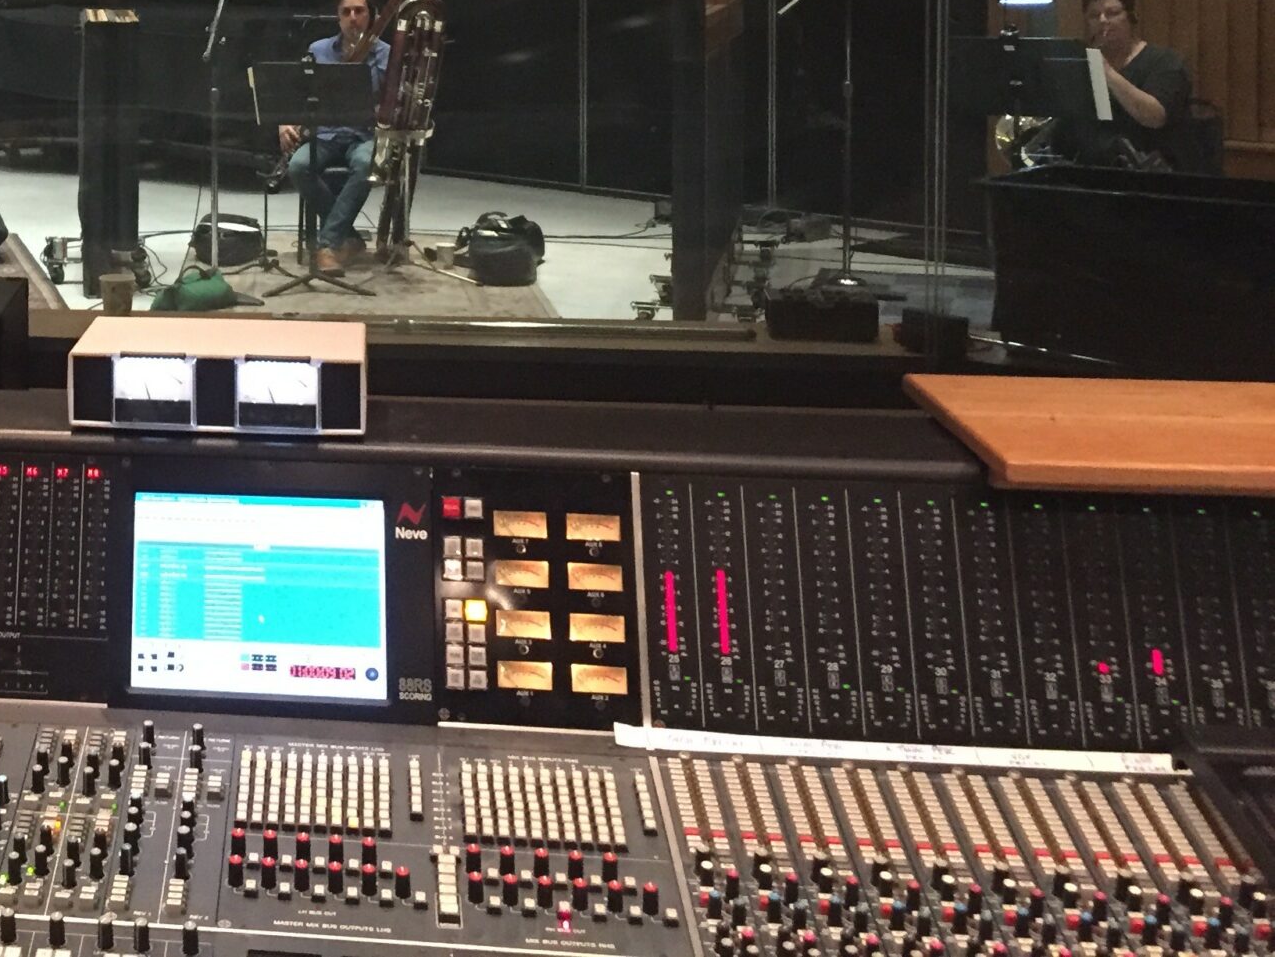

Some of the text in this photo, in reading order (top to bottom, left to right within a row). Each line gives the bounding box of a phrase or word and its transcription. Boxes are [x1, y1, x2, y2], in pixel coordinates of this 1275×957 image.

[395, 526, 428, 540] Neve
[774, 659, 784, 668] 27
[827, 662, 839, 671] 28
[880, 664, 893, 674] 29
[935, 667, 947, 676] 30
[990, 669, 1001, 678] 31
[1045, 672, 1057, 681] 32
[1099, 674, 1112, 684] 33
[399, 677, 432, 692] 88RS
[399, 692, 432, 701] SCORING
[339, 924, 374, 932] OUTPUTS
